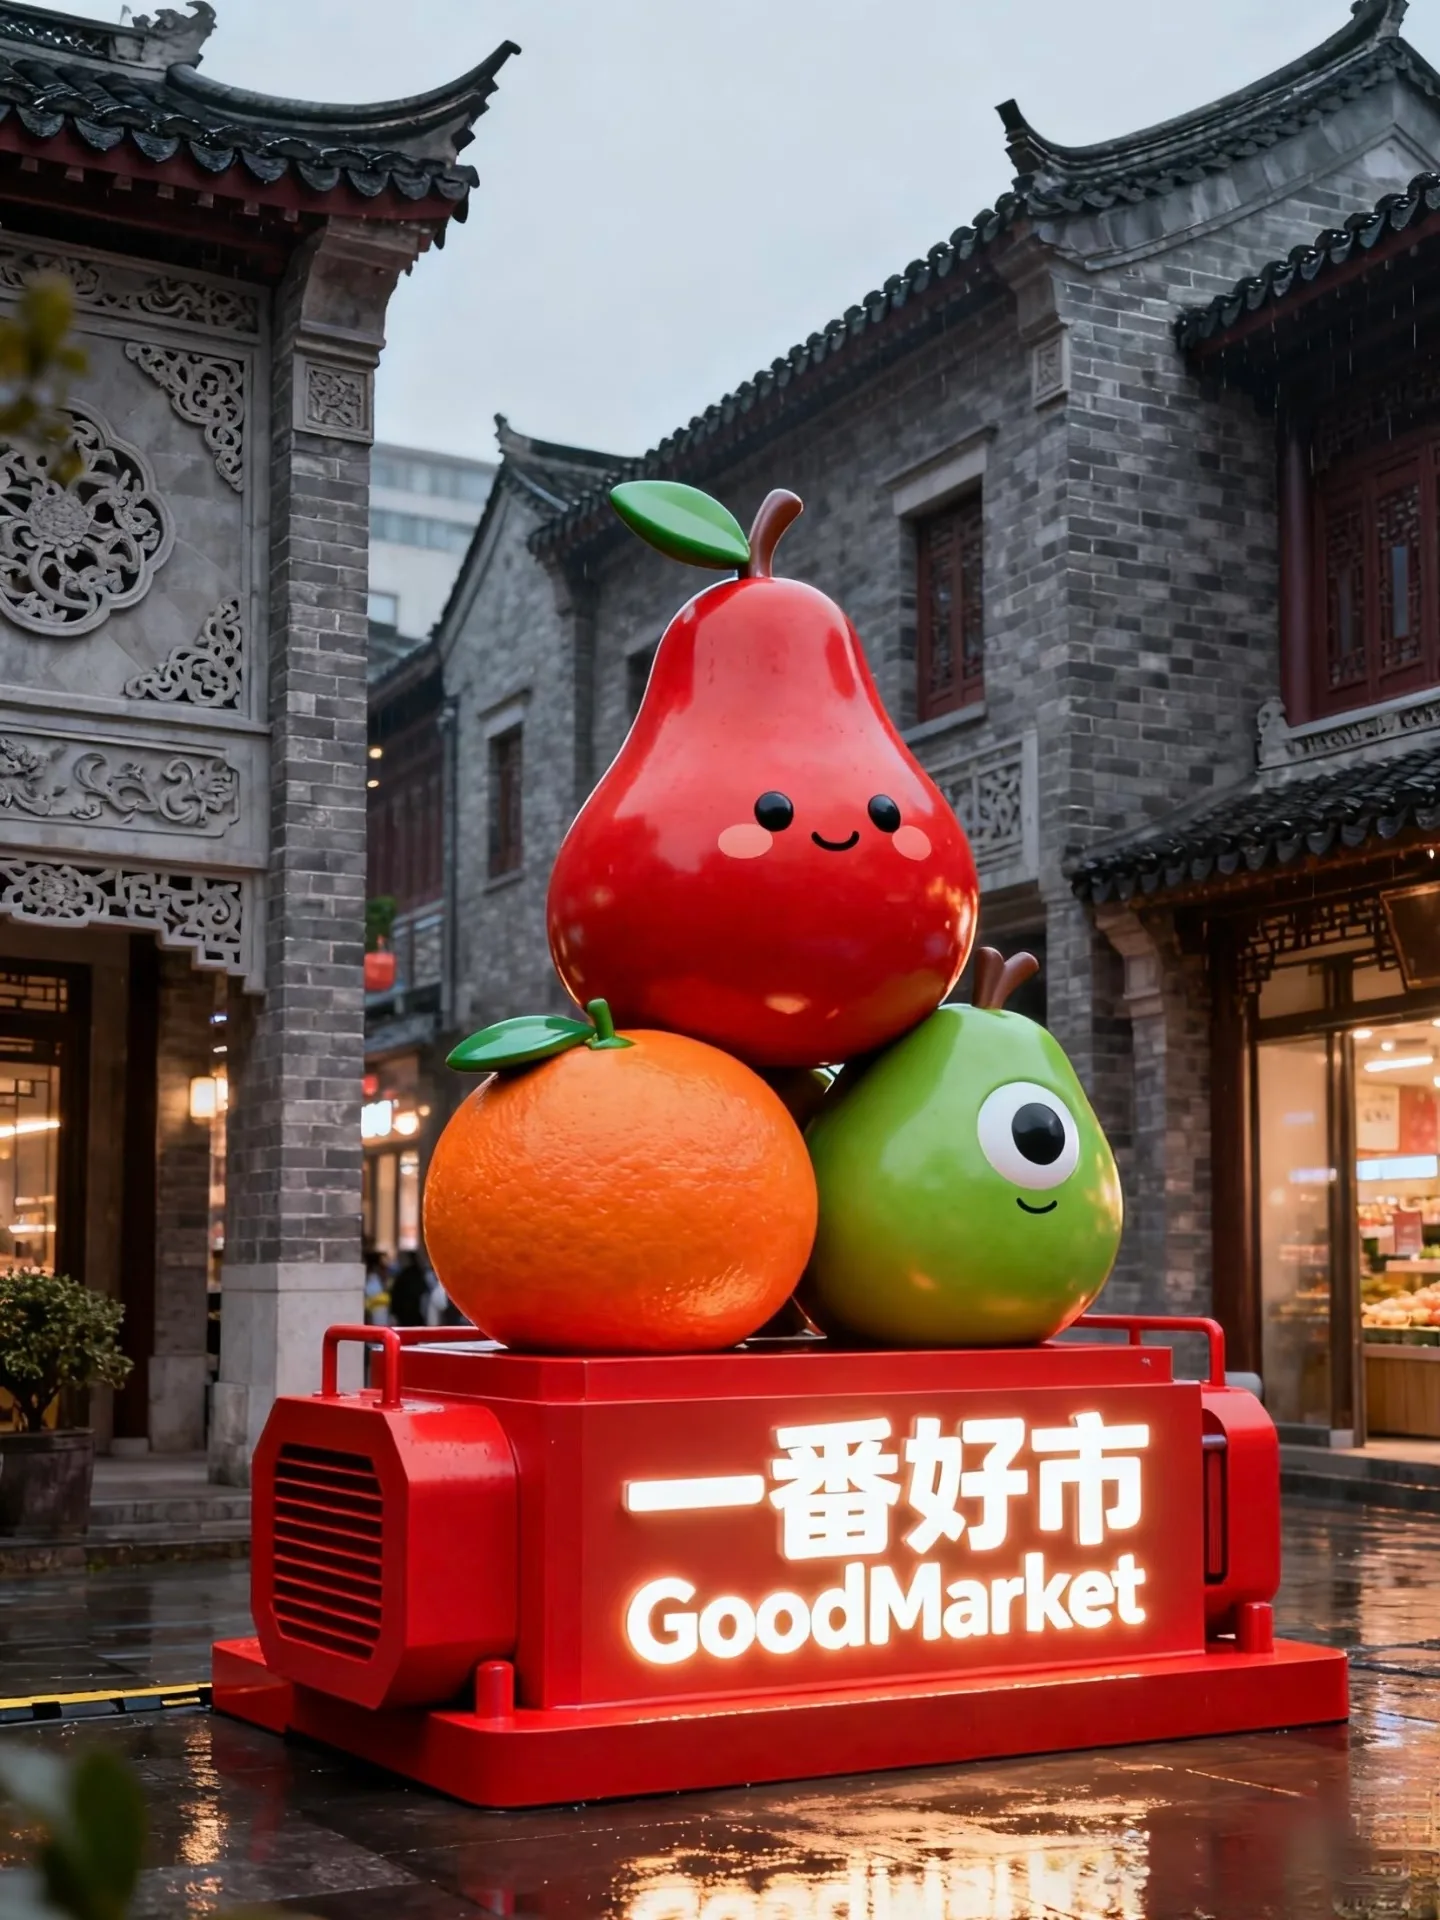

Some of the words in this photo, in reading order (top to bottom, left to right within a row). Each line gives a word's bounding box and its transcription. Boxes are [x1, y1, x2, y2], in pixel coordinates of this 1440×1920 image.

[626, 1411, 1150, 1561] 一番好市
[627, 1552, 1147, 1665] GoodMarket
